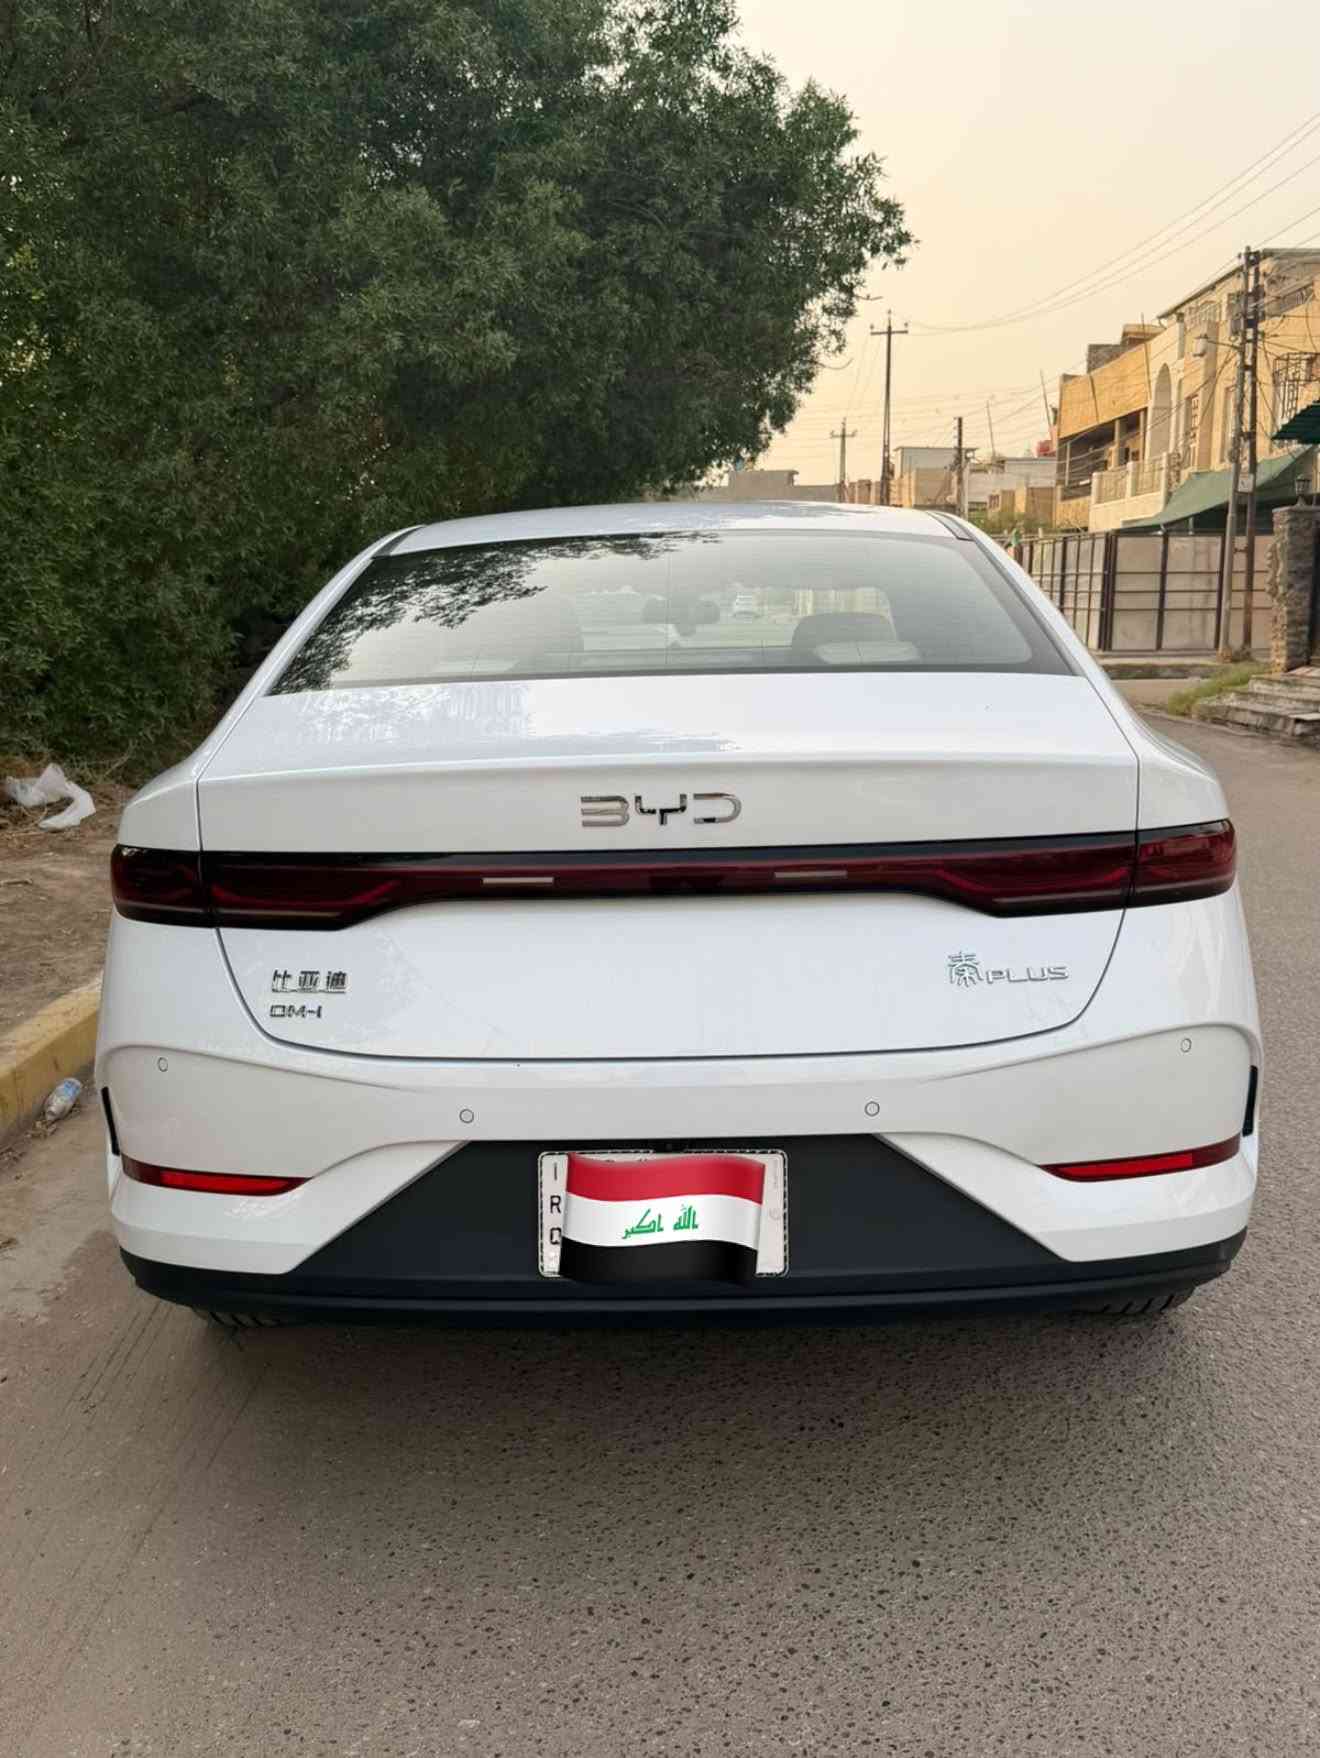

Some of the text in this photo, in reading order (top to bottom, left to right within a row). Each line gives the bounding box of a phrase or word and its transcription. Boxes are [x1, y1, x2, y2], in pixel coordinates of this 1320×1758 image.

[580, 793, 742, 827] BYD
[271, 969, 346, 993] 比亚迪
[986, 966, 1069, 984] PLUS
